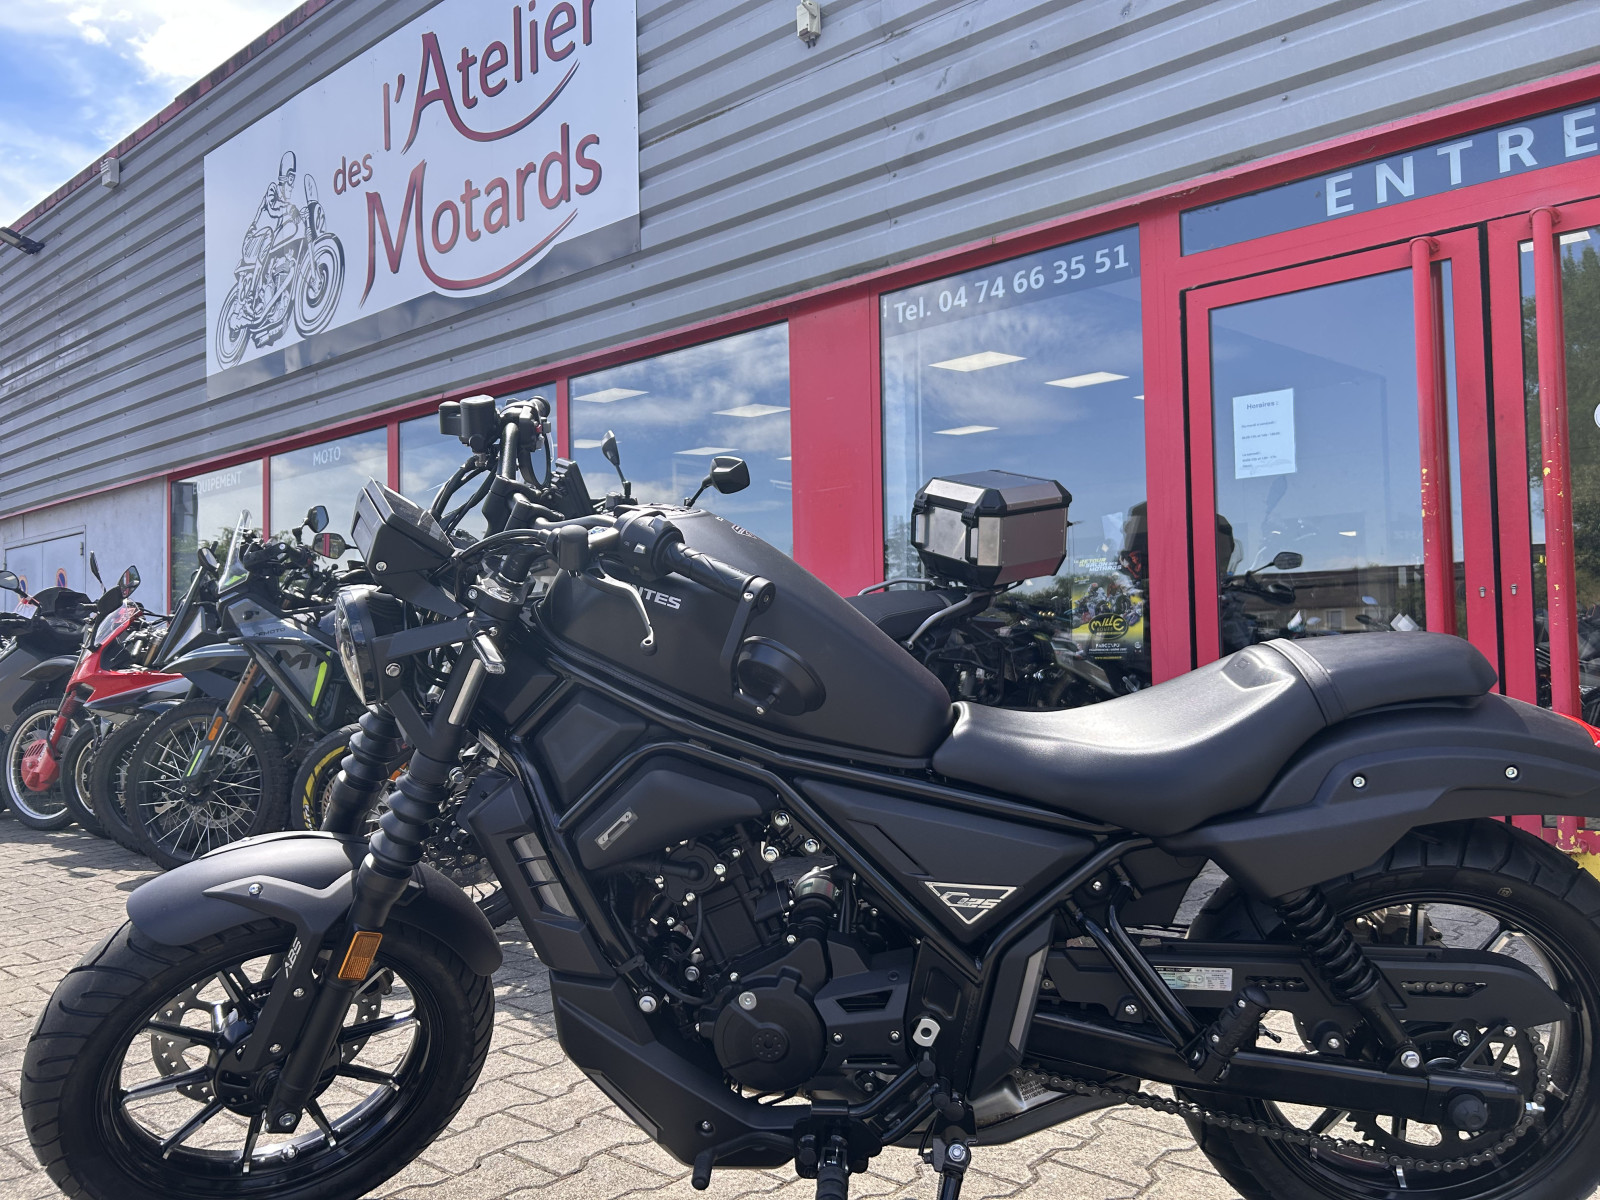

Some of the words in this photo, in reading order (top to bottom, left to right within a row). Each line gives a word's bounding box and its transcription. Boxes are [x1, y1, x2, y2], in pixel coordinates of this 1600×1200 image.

[333, 153, 374, 196] des
[359, 122, 603, 308] Motards
[893, 297, 932, 324] Tel.
[938, 286, 968, 313] 04
[974, 276, 1006, 304] 74
[1012, 266, 1045, 294] 66
[1052, 255, 1087, 284] 35
[1094, 244, 1130, 275] 51
[312, 446, 341, 467] MOTO
[192, 470, 242, 495] EQUIPEMENT
[631, 583, 682, 610] NTES
[283, 936, 302, 979] ABS
